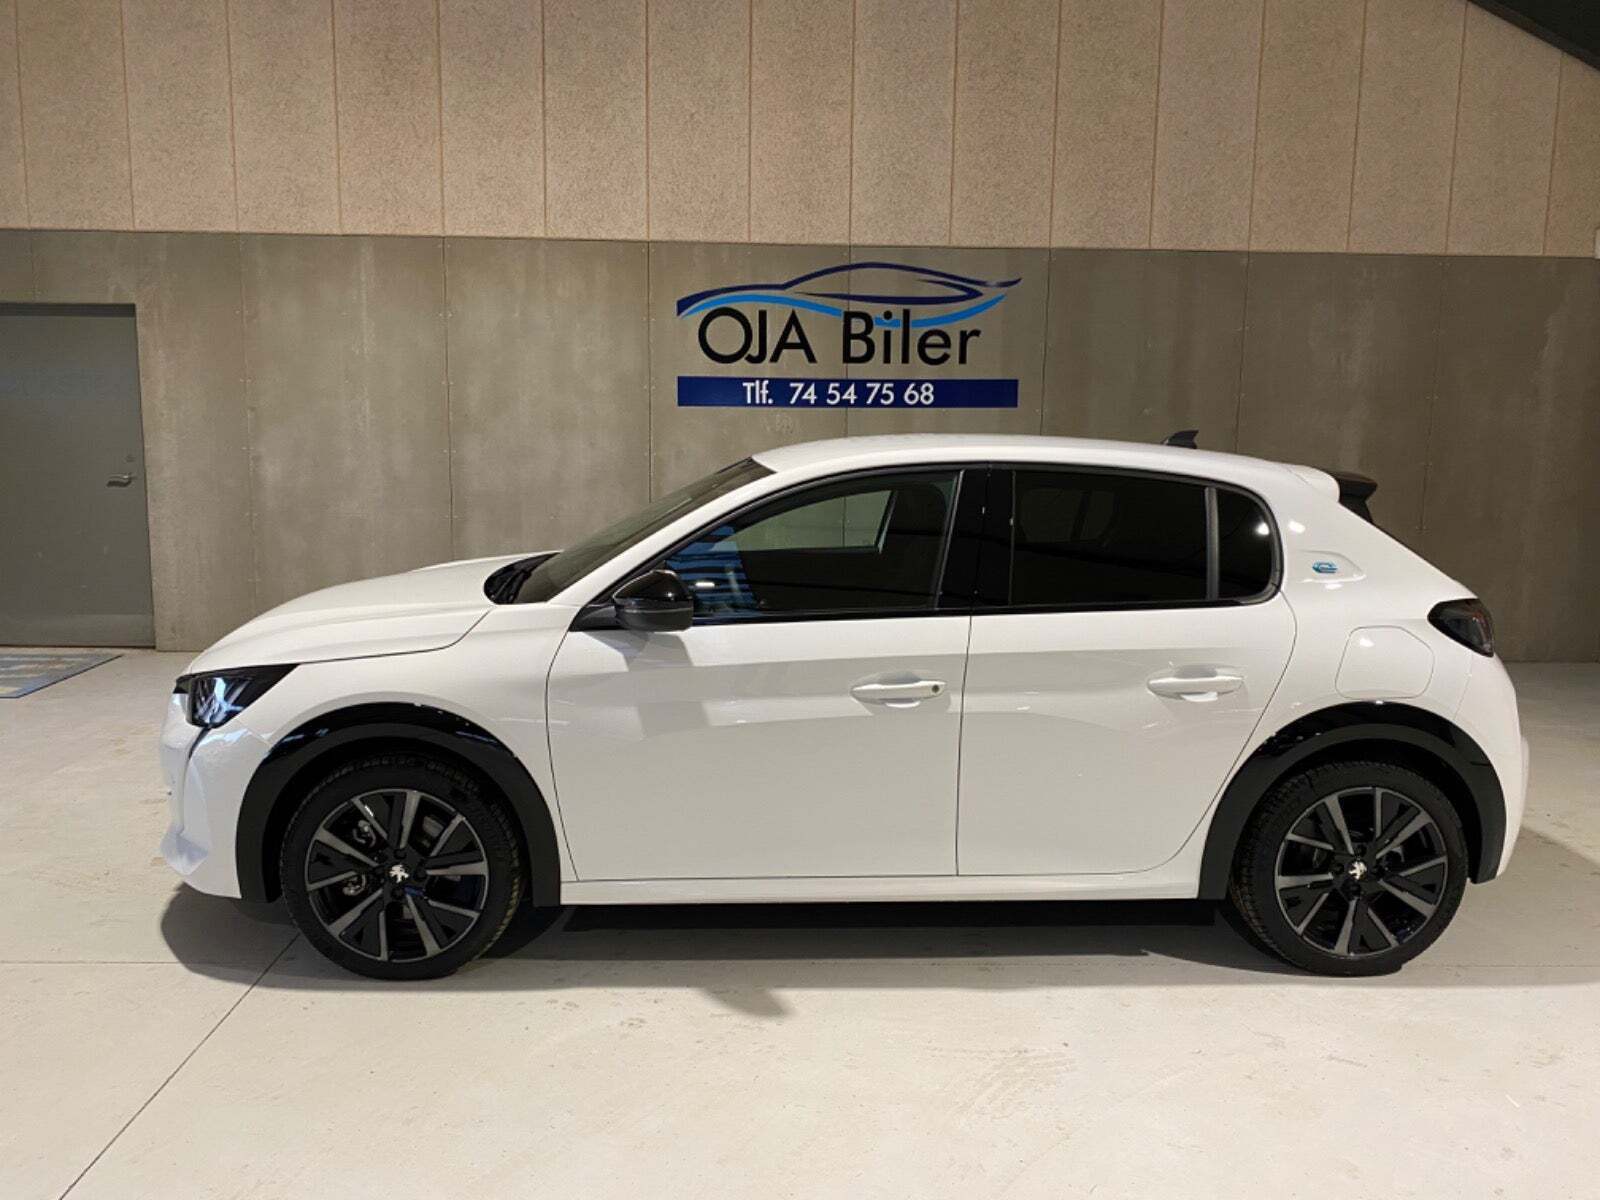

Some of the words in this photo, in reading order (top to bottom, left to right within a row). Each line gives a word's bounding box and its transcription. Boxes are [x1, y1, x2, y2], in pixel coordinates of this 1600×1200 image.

[698, 306, 817, 365] OJA
[842, 308, 981, 365] Biler
[743, 379, 773, 405] Tlf.
[789, 382, 817, 405] 74
[826, 382, 857, 405] 54
[866, 382, 895, 405] 75
[903, 383, 934, 406] 68
